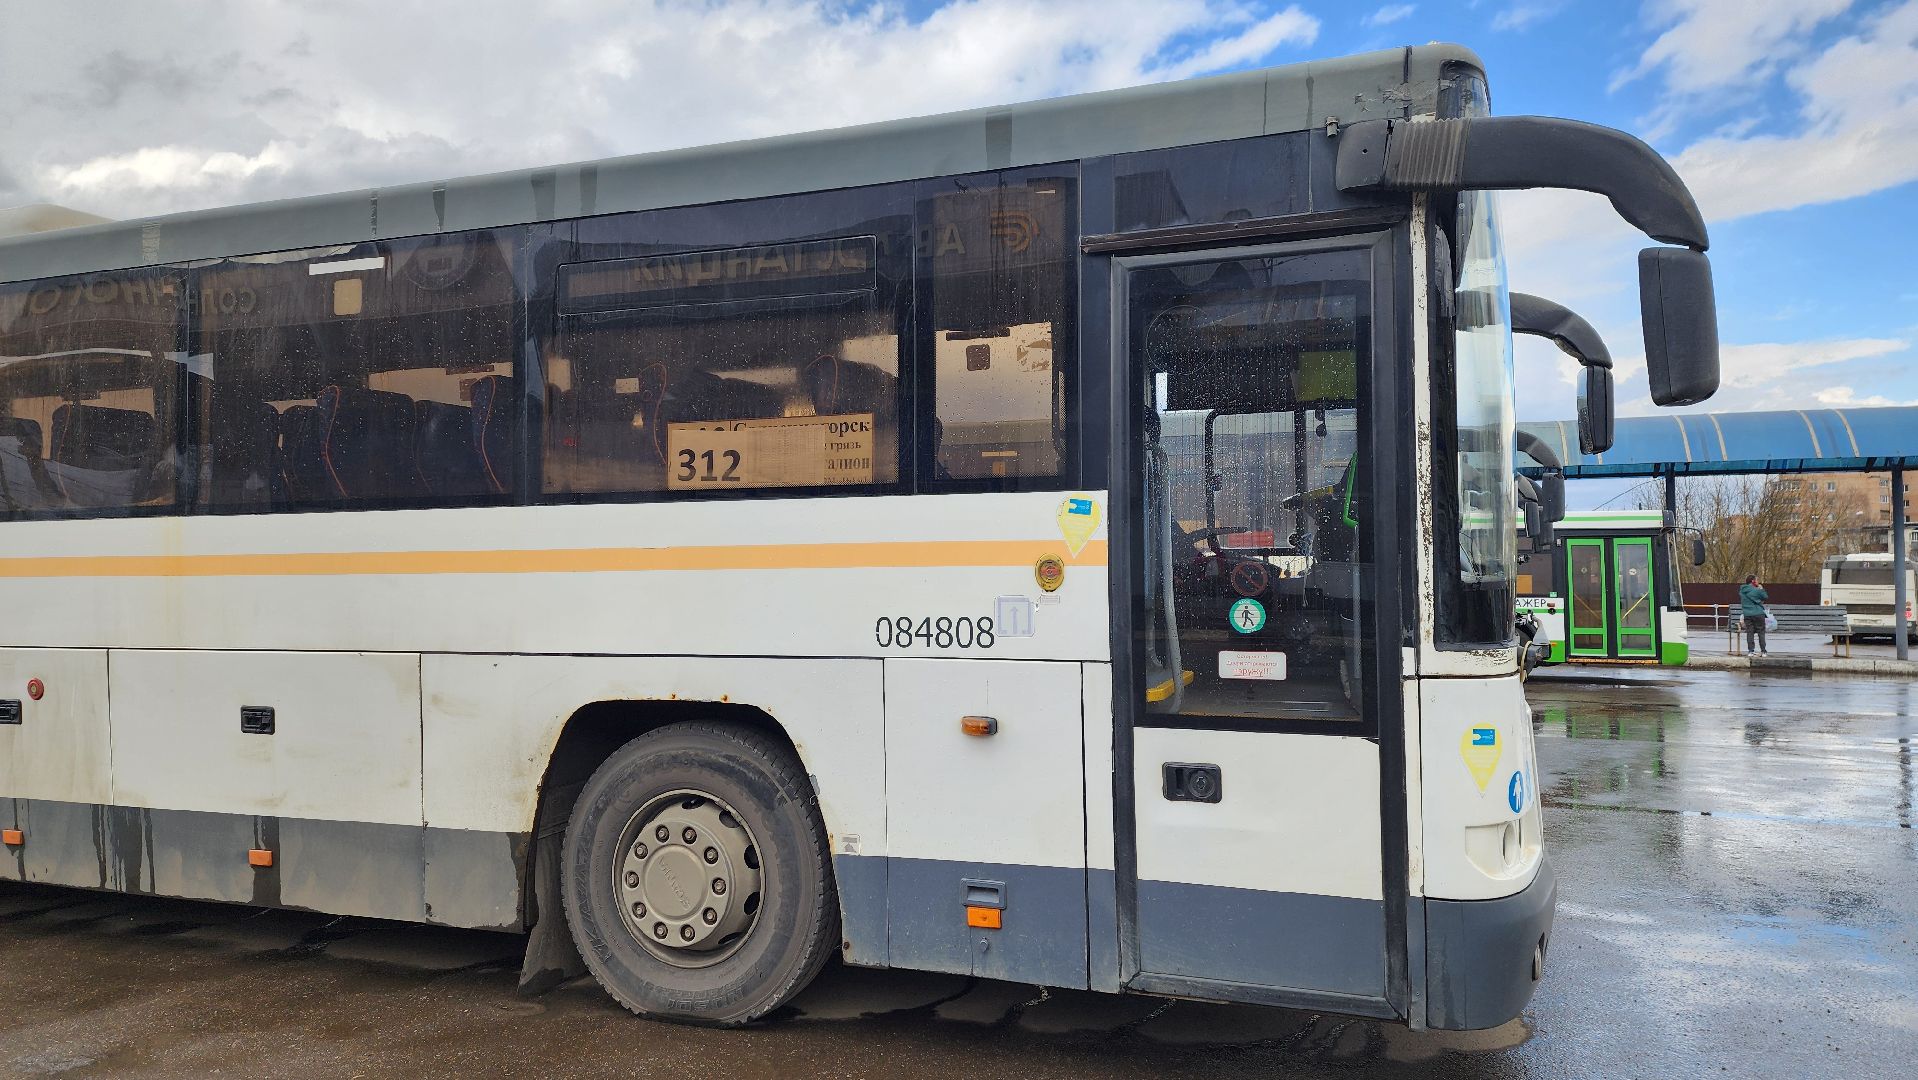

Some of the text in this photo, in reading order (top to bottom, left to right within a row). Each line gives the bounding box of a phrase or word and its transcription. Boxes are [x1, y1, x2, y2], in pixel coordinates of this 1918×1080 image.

[677, 448, 741, 482] 312
[826, 457, 870, 472] адион
[1514, 598, 1547, 608] АЖЕР
[876, 616, 995, 648] 084808
